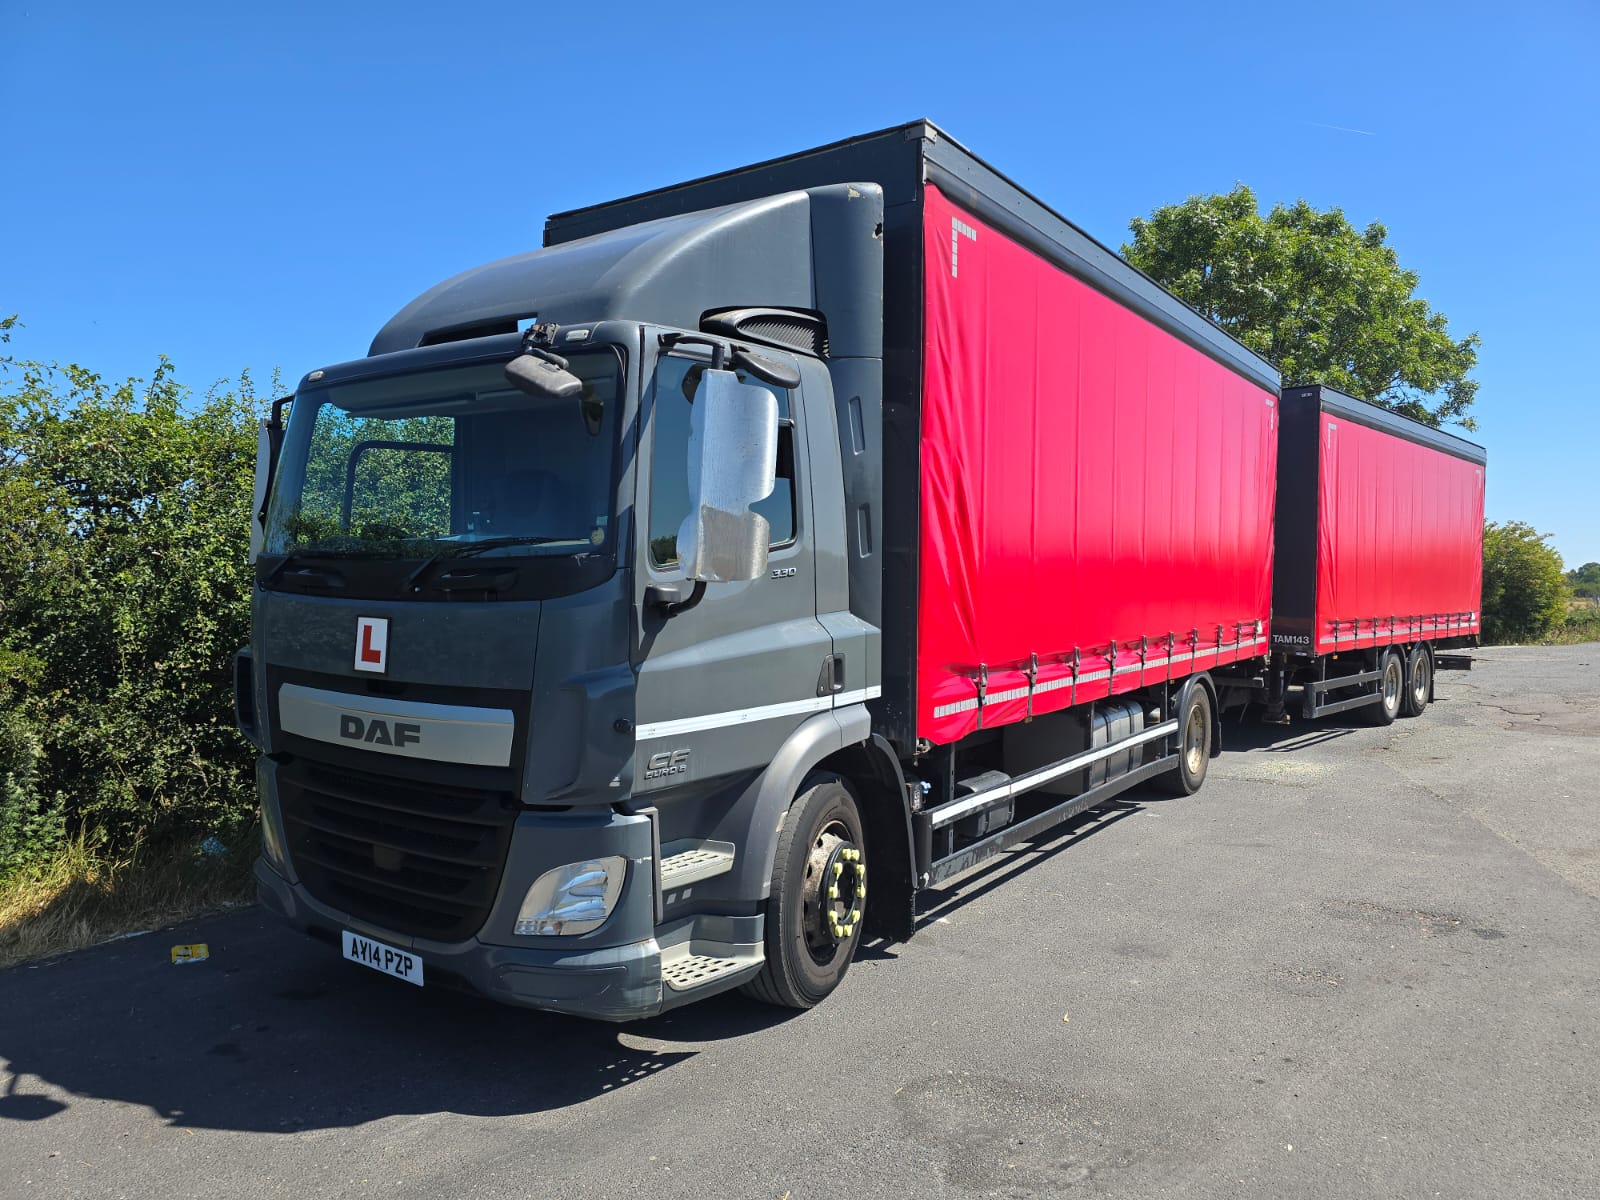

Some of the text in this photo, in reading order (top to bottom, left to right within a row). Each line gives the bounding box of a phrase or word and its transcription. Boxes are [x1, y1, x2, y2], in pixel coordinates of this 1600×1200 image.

[771, 567, 797, 579] 330
[361, 625, 381, 664] L
[1272, 634, 1310, 645] TAM143
[340, 714, 420, 747] DAF
[648, 749, 691, 770] CF
[644, 766, 677, 780] EURO
[351, 937, 413, 977] AY14 PZP
